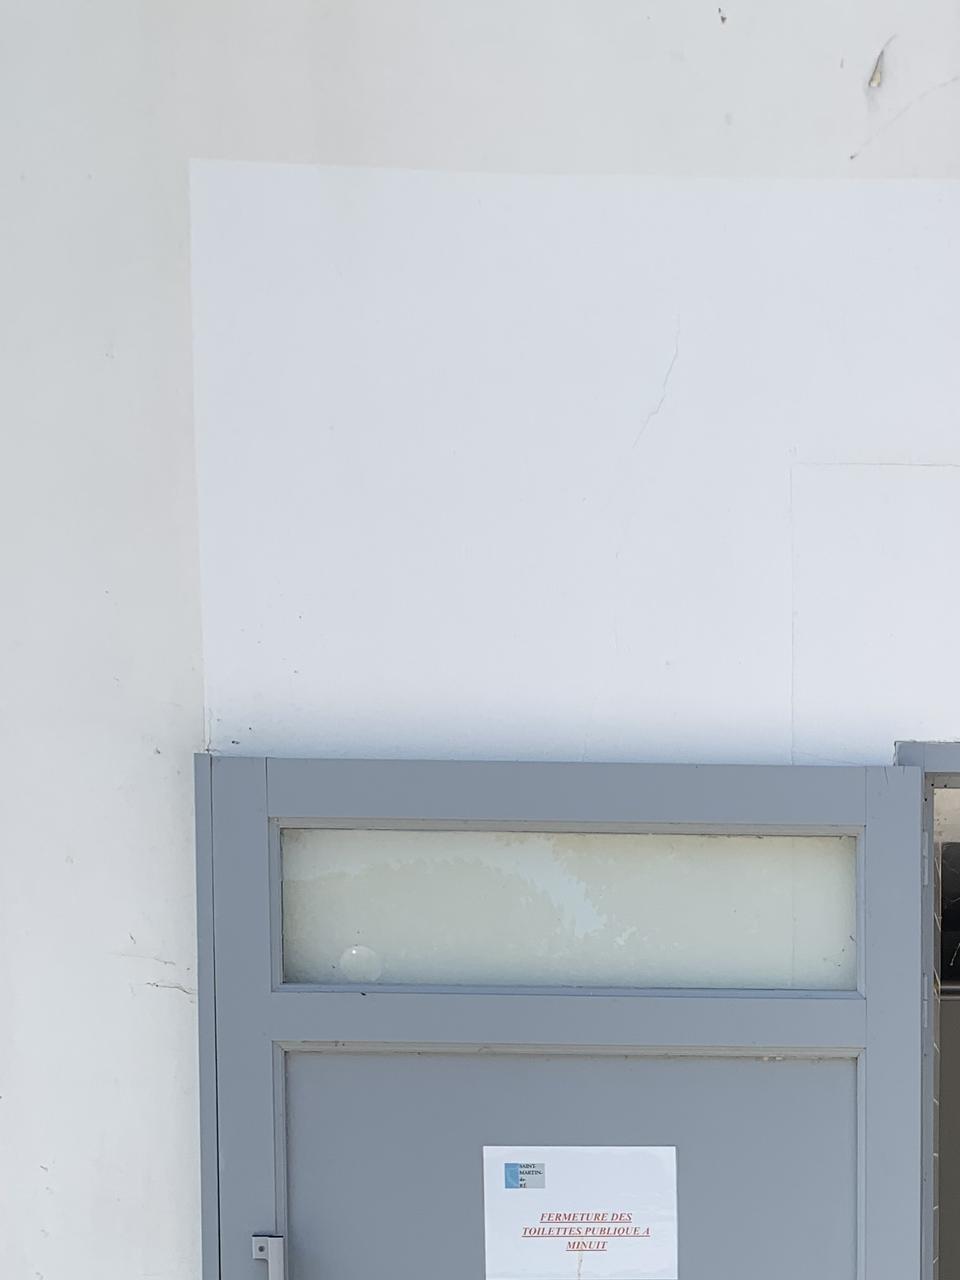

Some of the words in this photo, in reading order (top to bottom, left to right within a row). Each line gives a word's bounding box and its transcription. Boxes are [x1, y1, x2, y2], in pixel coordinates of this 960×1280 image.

[540, 1212, 608, 1222] FERMETURE
[611, 1212, 632, 1222] DES
[522, 1226, 582, 1236] TOILETTES
[584, 1226, 641, 1236] PUBLIQUE
[642, 1226, 651, 1236] A
[566, 1240, 608, 1250] MINUIT
